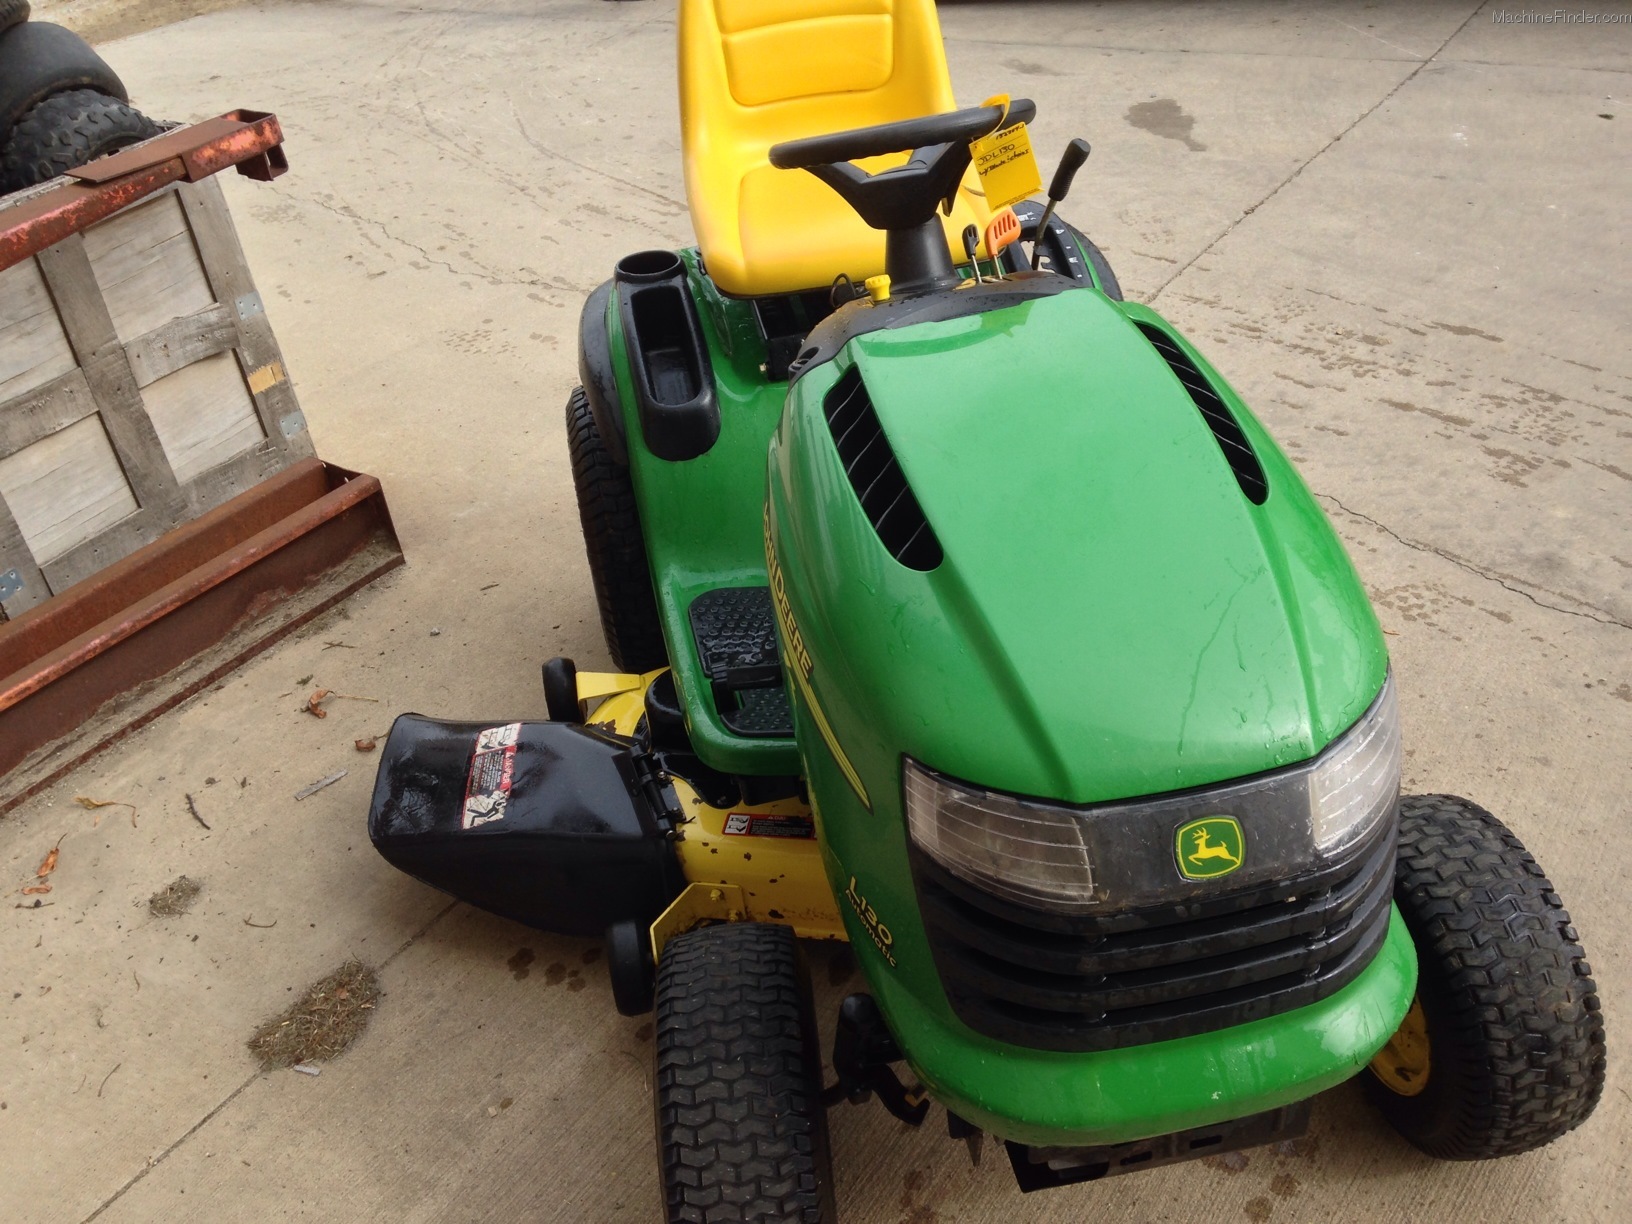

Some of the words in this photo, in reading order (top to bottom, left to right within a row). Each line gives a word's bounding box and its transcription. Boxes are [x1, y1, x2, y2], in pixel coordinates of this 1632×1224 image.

[775, 566, 812, 679] DEERE
[845, 889, 897, 967] Automatic
[849, 876, 893, 945] L130
